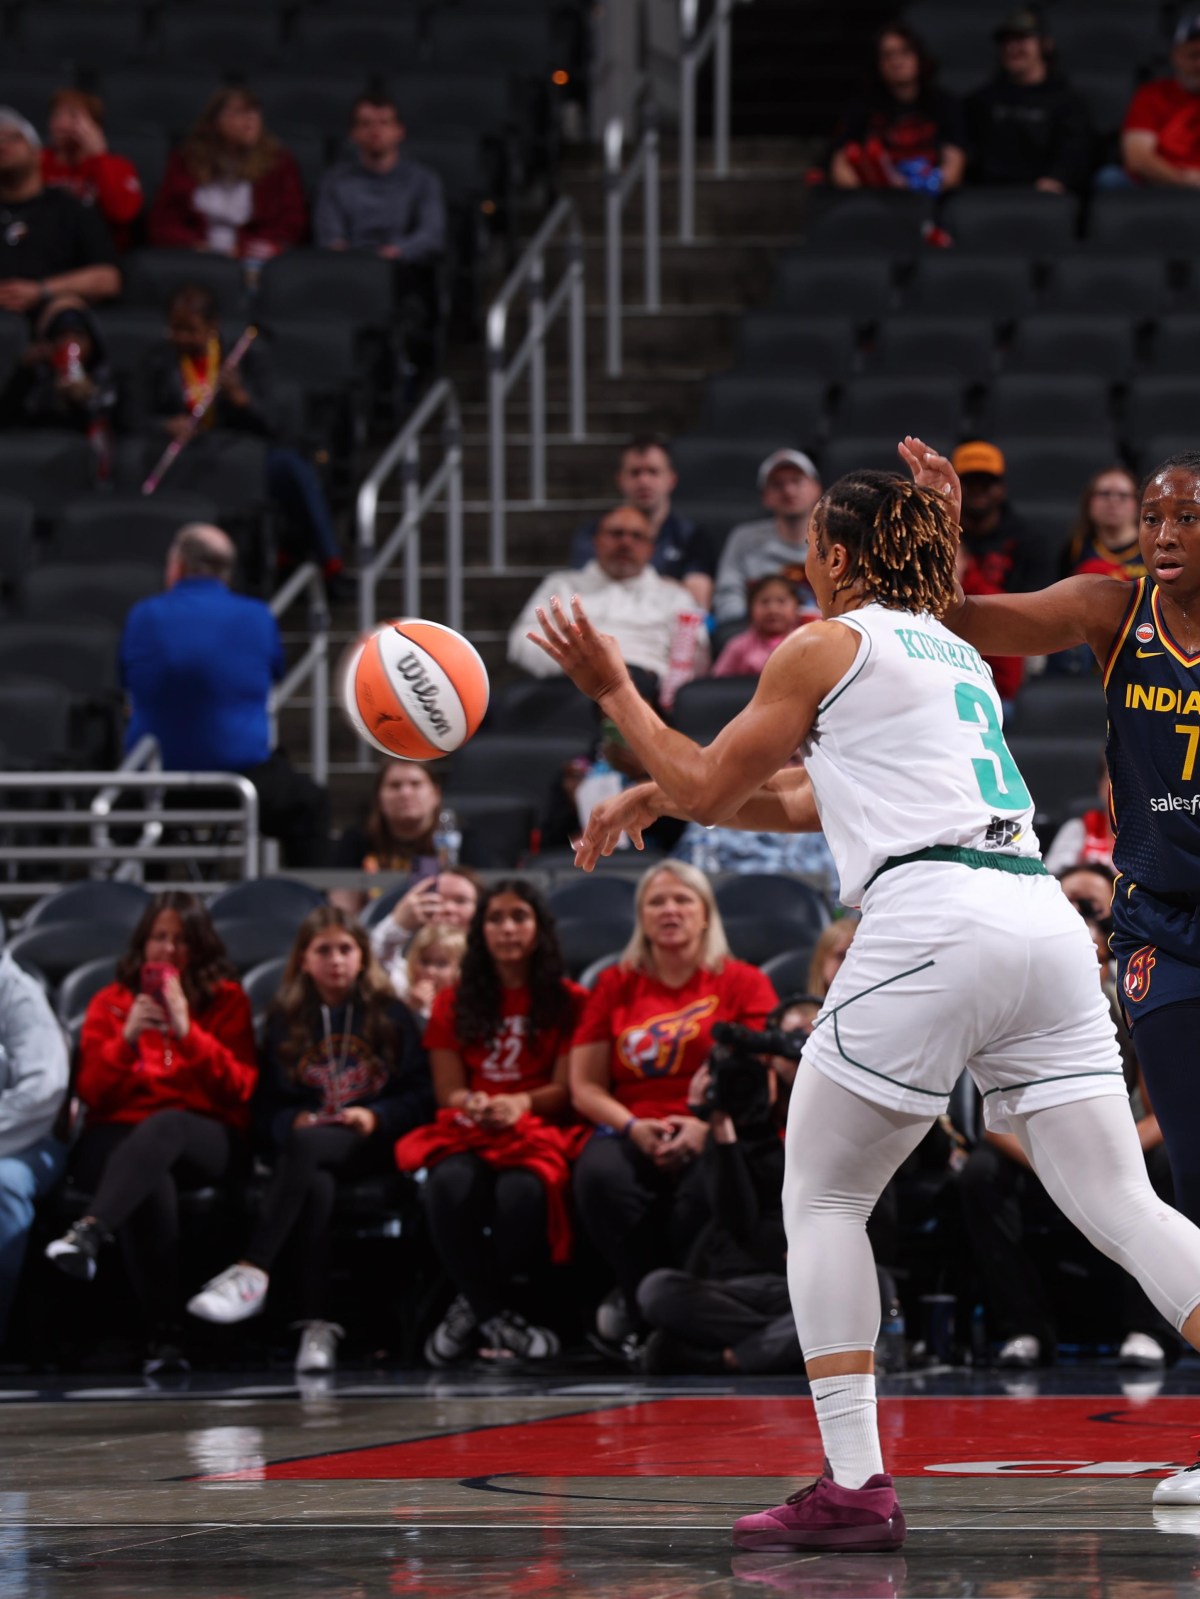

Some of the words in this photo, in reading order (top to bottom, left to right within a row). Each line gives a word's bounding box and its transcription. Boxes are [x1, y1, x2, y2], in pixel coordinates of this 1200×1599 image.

[396, 651, 452, 738] Wilson
[954, 681, 1033, 812] 3
[1175, 724, 1200, 781] 7
